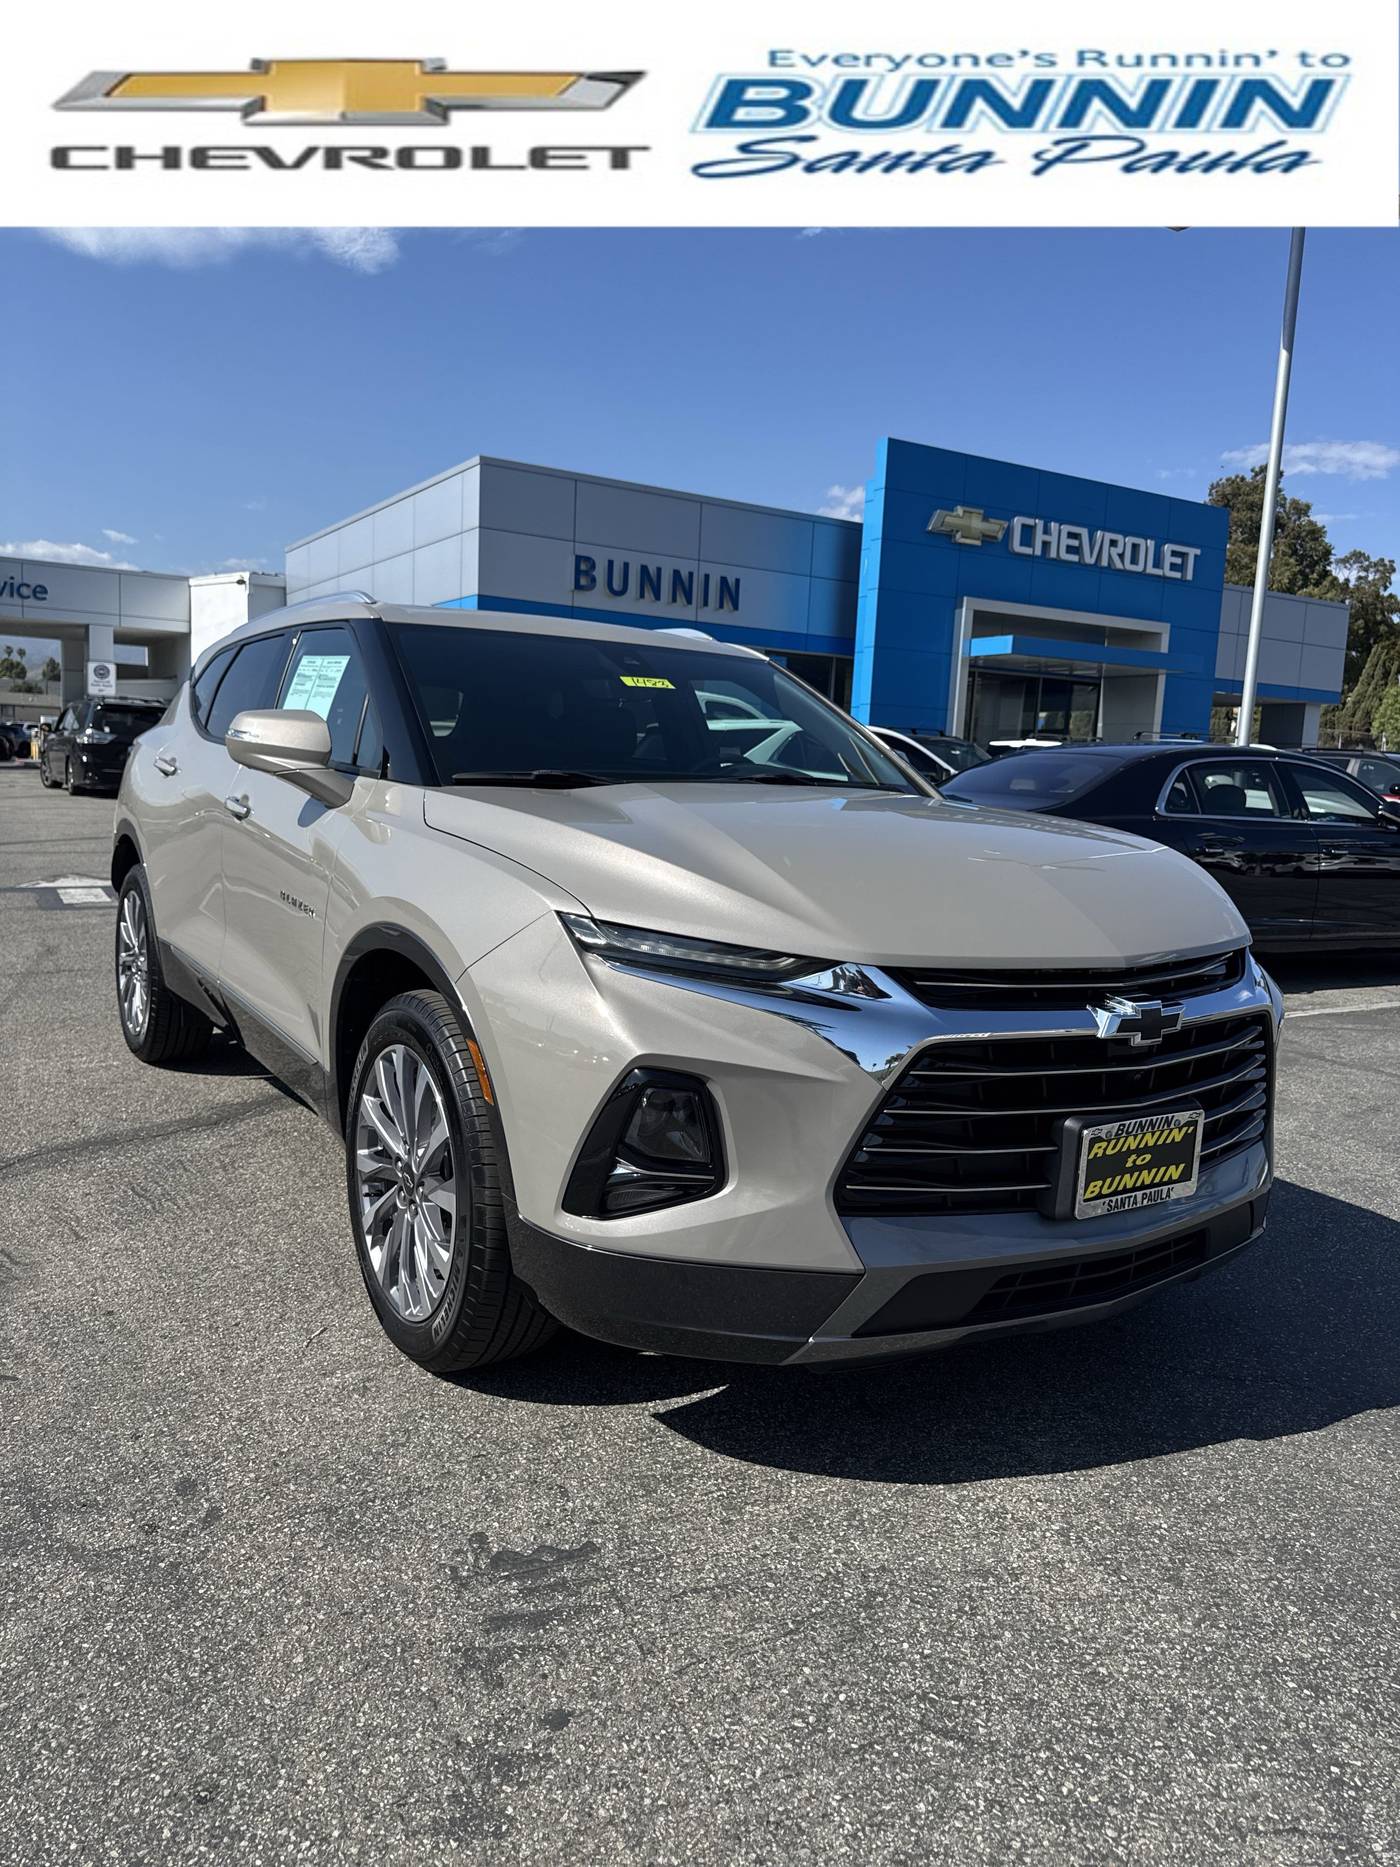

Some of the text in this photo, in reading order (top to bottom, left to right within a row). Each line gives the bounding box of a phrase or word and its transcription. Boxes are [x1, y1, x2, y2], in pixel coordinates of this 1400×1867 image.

[1009, 515, 1201, 581] CHEVROLET
[574, 554, 741, 611] BUNNIN
[1115, 1115, 1175, 1137] BUNNIN
[1125, 1153, 1151, 1168] to
[1083, 1163, 1185, 1200] BUNNIN
